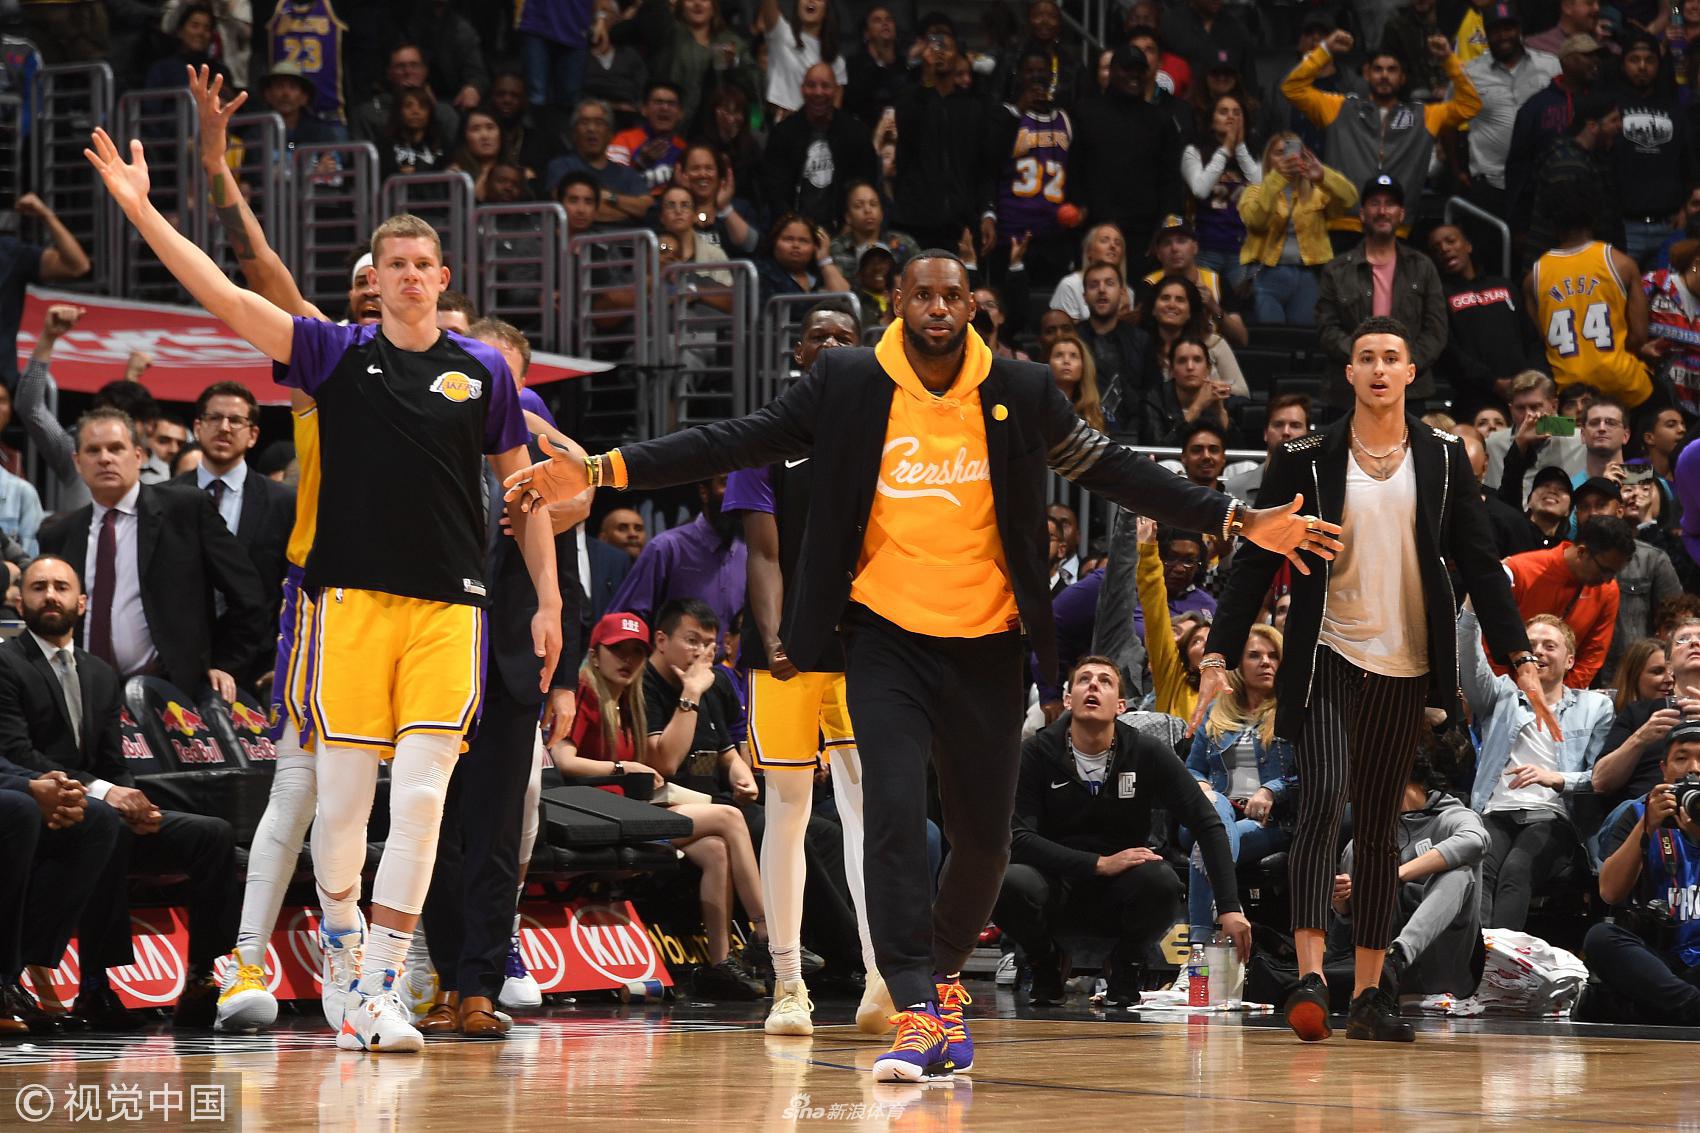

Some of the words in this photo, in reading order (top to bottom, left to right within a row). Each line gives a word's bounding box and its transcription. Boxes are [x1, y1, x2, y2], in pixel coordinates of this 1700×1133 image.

[283, 37, 323, 73] 23
[1012, 157, 1066, 204] 32
[1549, 275, 1601, 303] WEST
[1548, 302, 1615, 358] 44
[1662, 836, 1673, 855] EOS
[578, 924, 648, 966] KIA
